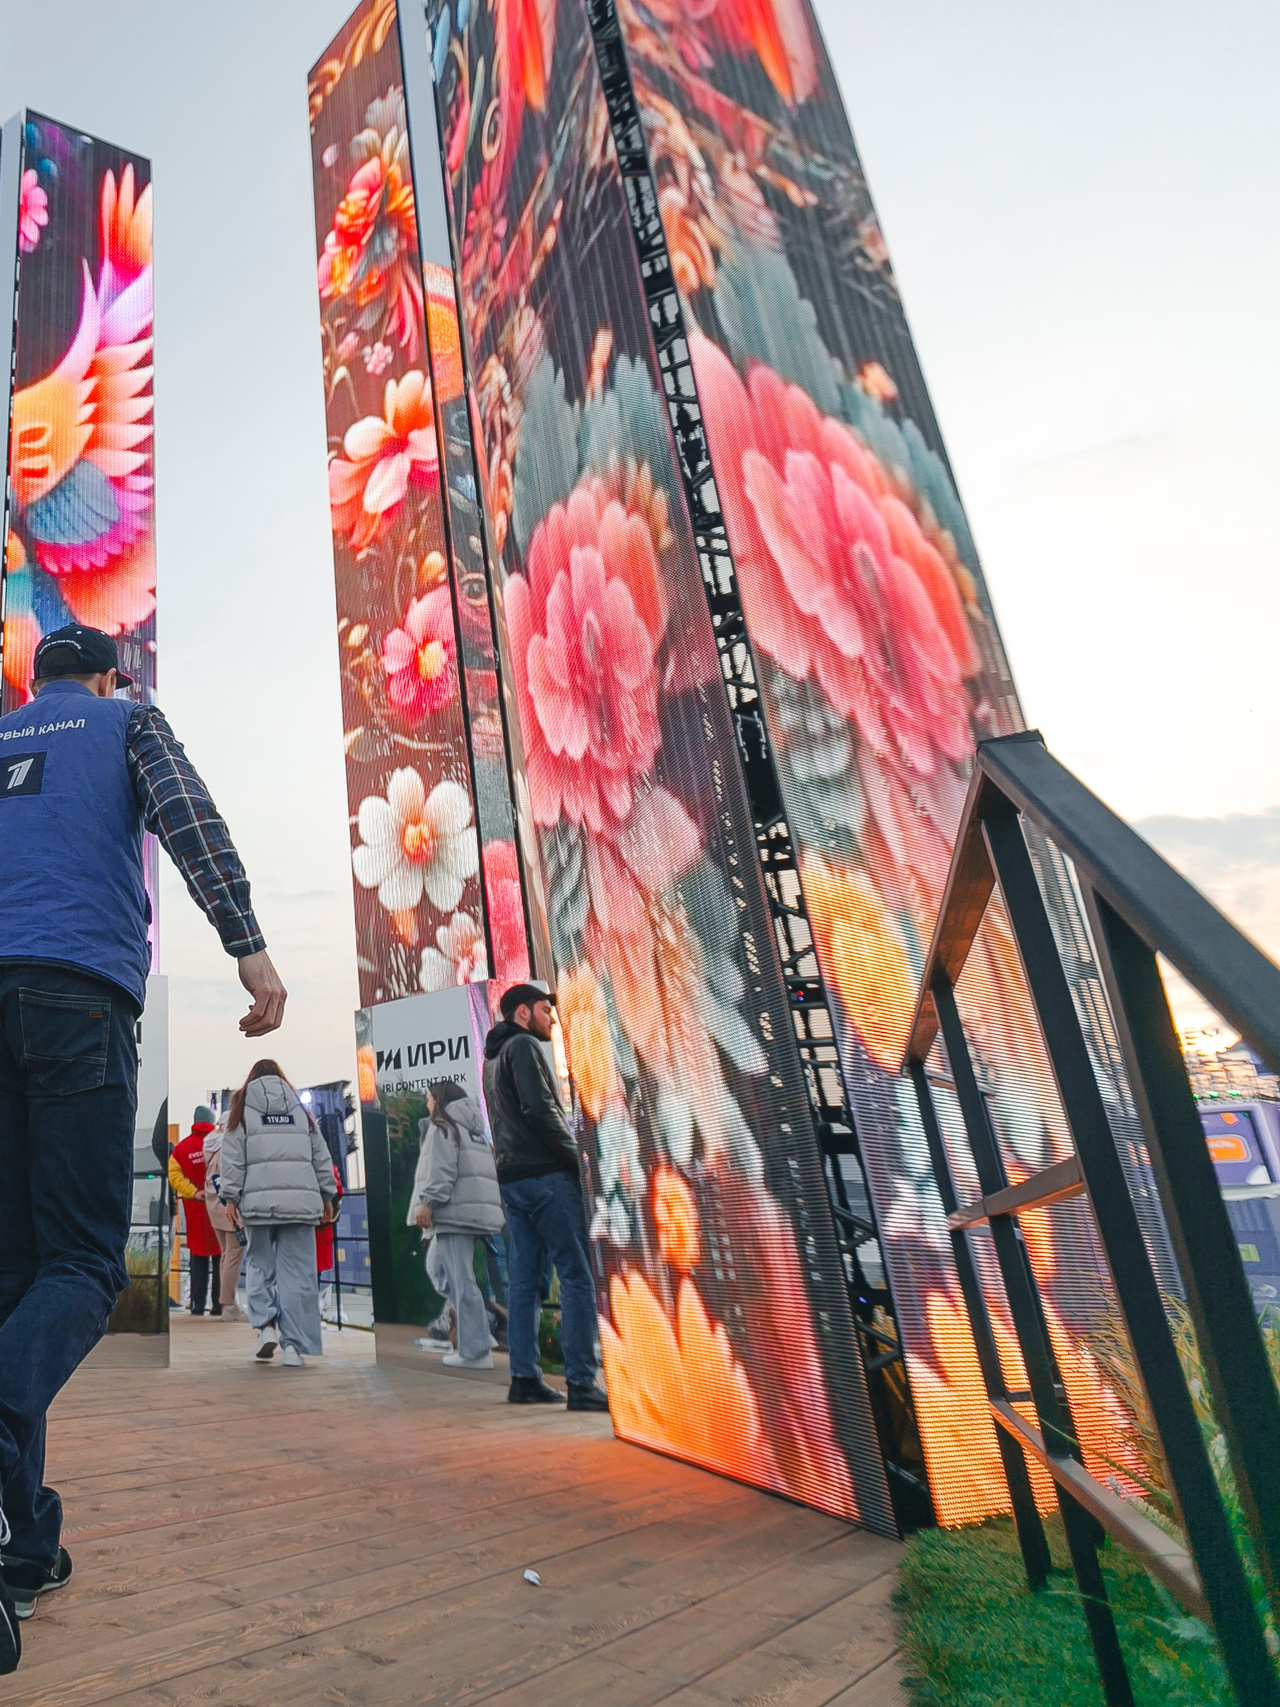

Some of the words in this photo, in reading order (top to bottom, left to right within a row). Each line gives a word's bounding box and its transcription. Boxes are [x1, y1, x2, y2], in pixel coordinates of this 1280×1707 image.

[38, 718, 86, 735] КАНАЛ
[407, 1035, 470, 1068] ИРИ
[382, 1083, 395, 1094] IRI
[395, 1076, 439, 1092] CONTENT
[441, 1072, 468, 1086] PARK
[266, 1115, 290, 1124] 1TV.RU
